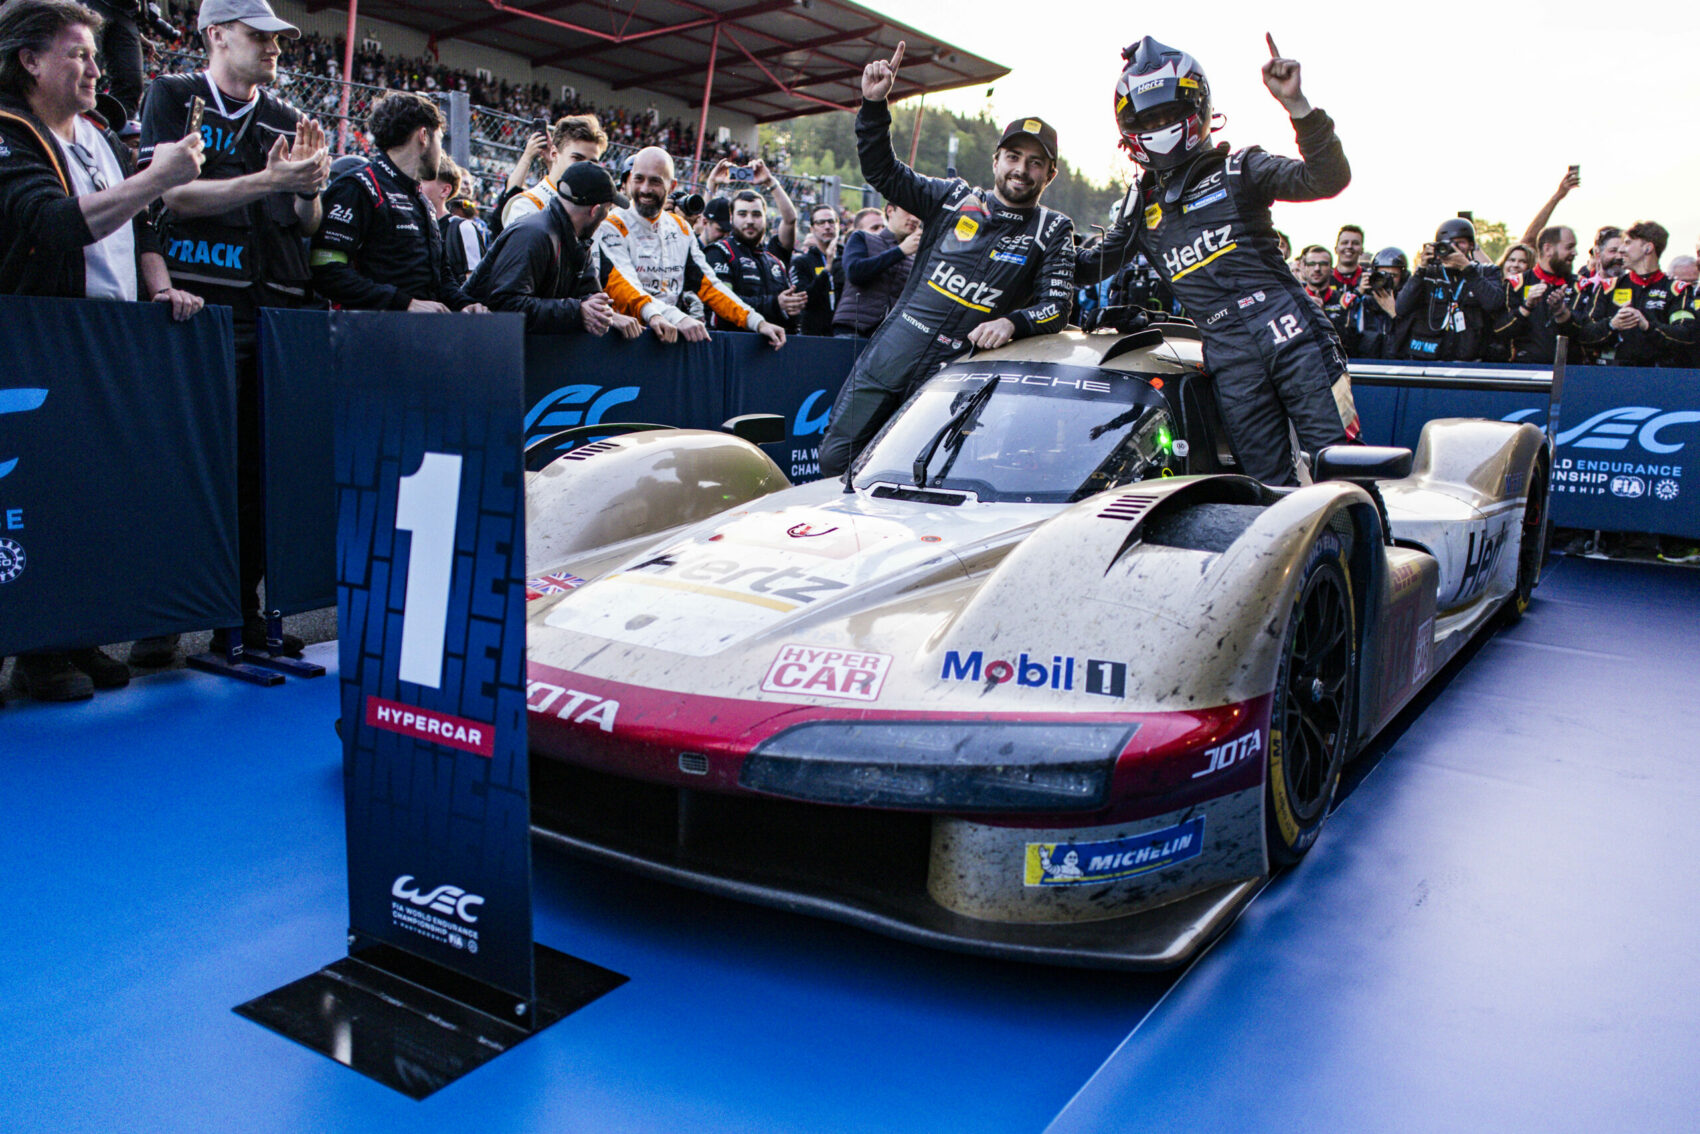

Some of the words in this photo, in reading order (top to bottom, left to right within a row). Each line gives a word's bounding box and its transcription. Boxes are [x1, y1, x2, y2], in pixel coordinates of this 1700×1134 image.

[1137, 79, 1164, 93] Hertz
[997, 211, 1024, 221] JOTA
[1044, 214, 1065, 238] HRX
[168, 237, 244, 270] TRACK
[1163, 224, 1237, 276] Hertz
[930, 261, 1003, 307] Hertz
[1029, 303, 1059, 320] Hertz
[1267, 314, 1303, 344] 12
[792, 449, 808, 461] FIA
[1576, 460, 1682, 477] ENDURANCE
[1552, 471, 1608, 484] NSHIP
[1612, 478, 1641, 494] FIA
[395, 452, 462, 689] 1
[783, 648, 880, 670] HYPER
[941, 651, 1074, 691] Mobil
[1098, 662, 1113, 695] 1
[772, 662, 876, 696] CAR
[527, 680, 620, 733] OTA
[377, 706, 483, 745] HYPERCAR
[1192, 729, 1261, 778] JOTA
[1088, 833, 1193, 871] MICHELIN
[392, 875, 485, 923] WEC
[392, 910, 448, 936] CHAMPIONSHIP
[405, 907, 432, 922] WORLD
[432, 917, 478, 940] ENDURANCE
